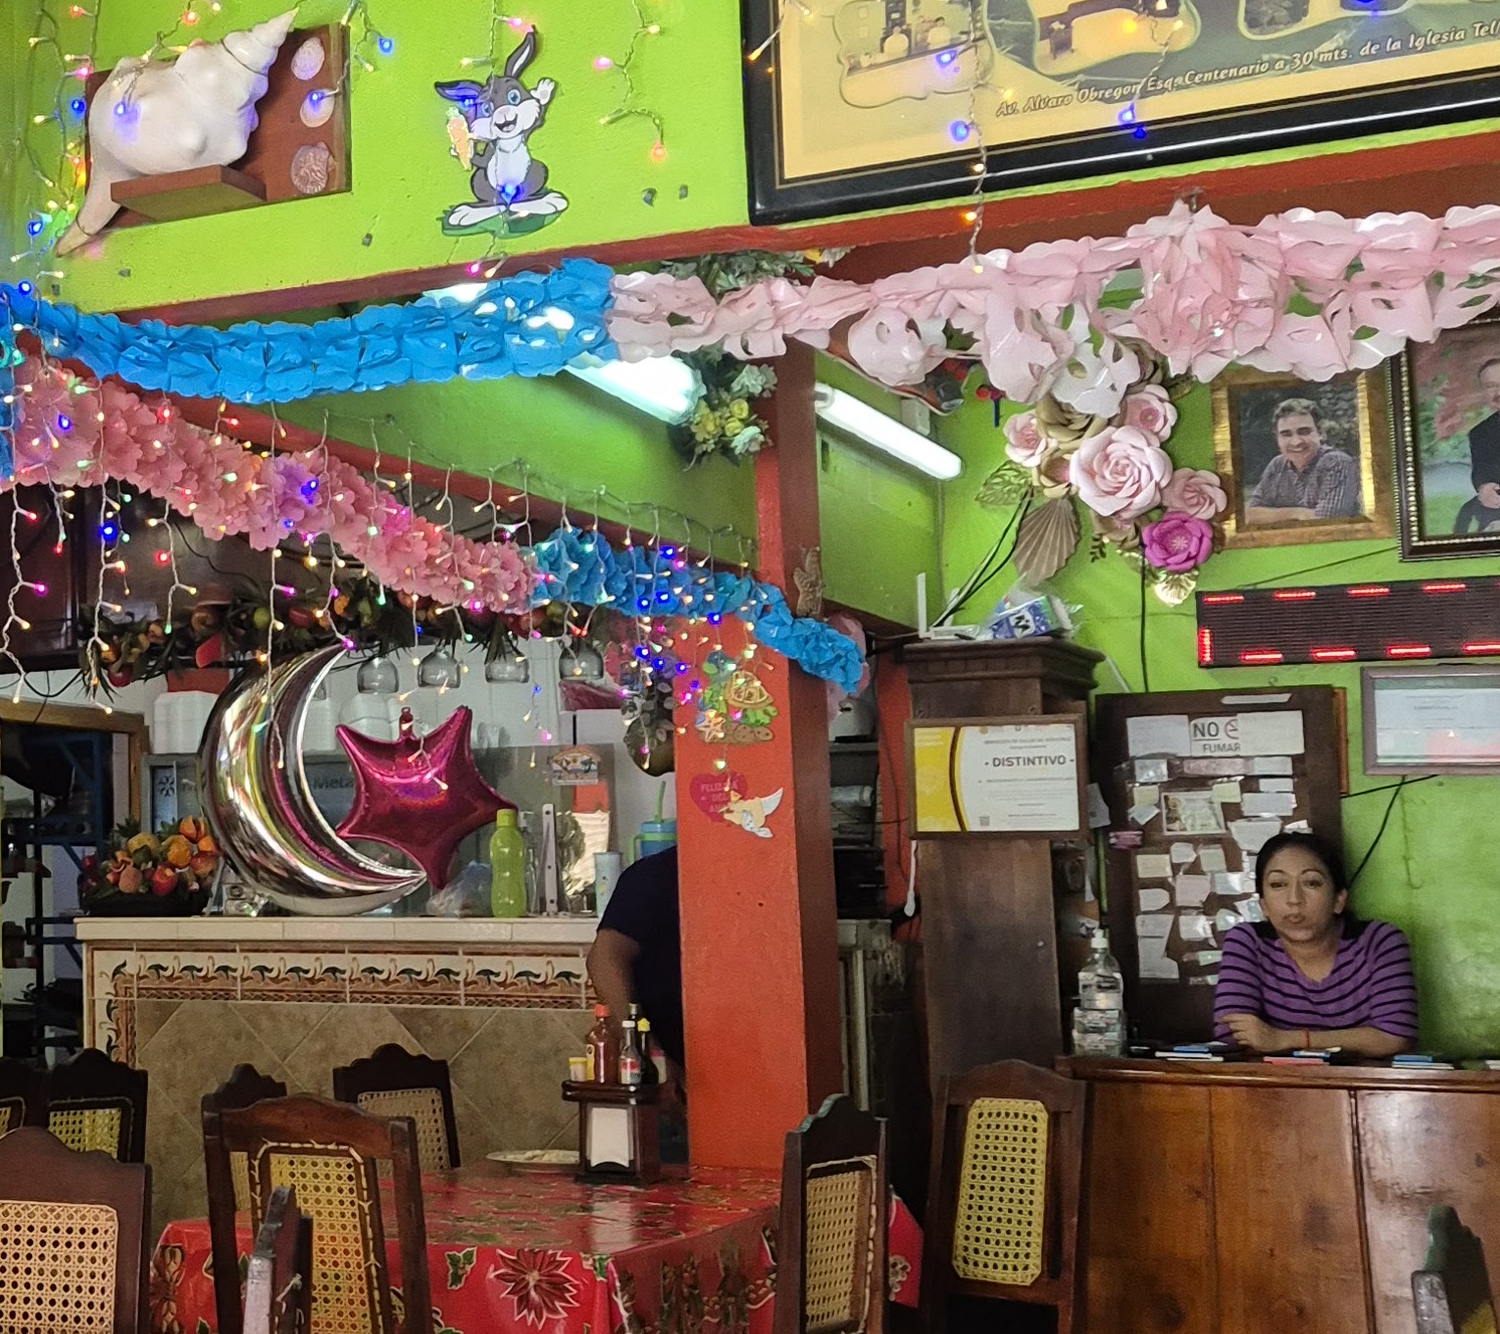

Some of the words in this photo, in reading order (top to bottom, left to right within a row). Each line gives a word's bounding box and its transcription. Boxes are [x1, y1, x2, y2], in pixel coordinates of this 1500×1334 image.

[996, 100, 1020, 118] Av.
[1184, 58, 1269, 85] Centenario
[1275, 58, 1286, 70] a
[1291, 53, 1313, 70] 30
[1317, 47, 1353, 64] mts.
[1359, 40, 1380, 57] de
[1386, 37, 1402, 52] la
[1408, 26, 1466, 51] Iglesia
[1193, 722, 1219, 738] NO
[1203, 743, 1241, 754] FUMAR
[992, 755, 1067, 767] DISTINTIVO
